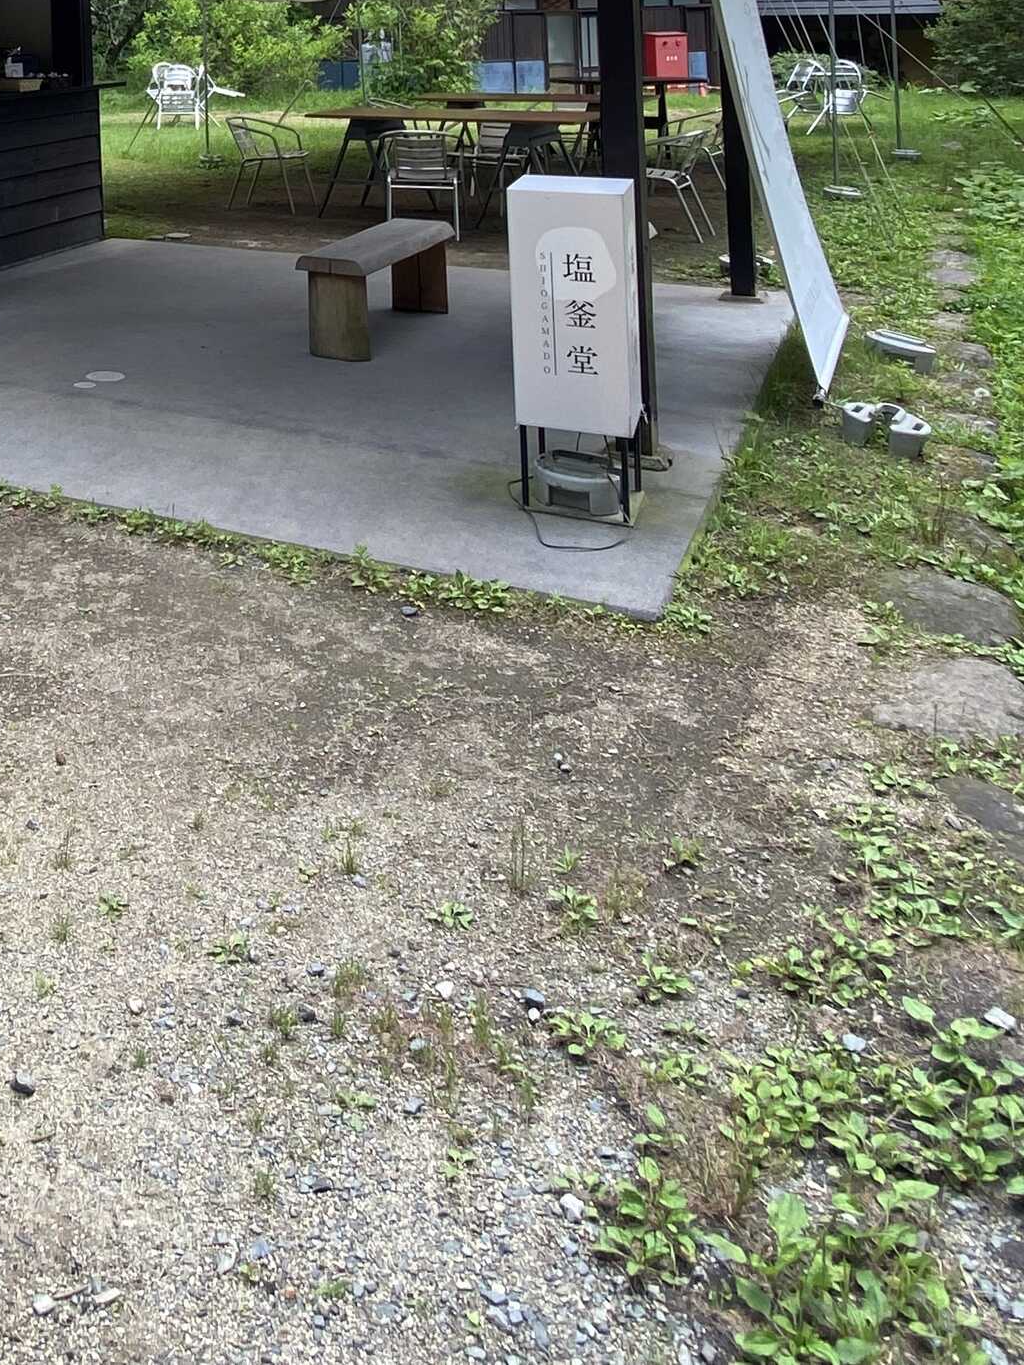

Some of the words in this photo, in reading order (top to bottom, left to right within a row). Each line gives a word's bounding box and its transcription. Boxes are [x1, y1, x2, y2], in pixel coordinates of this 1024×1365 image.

[539, 252, 551, 375] SHIOGAMADO
[562, 253, 599, 376] 塩釜堂
